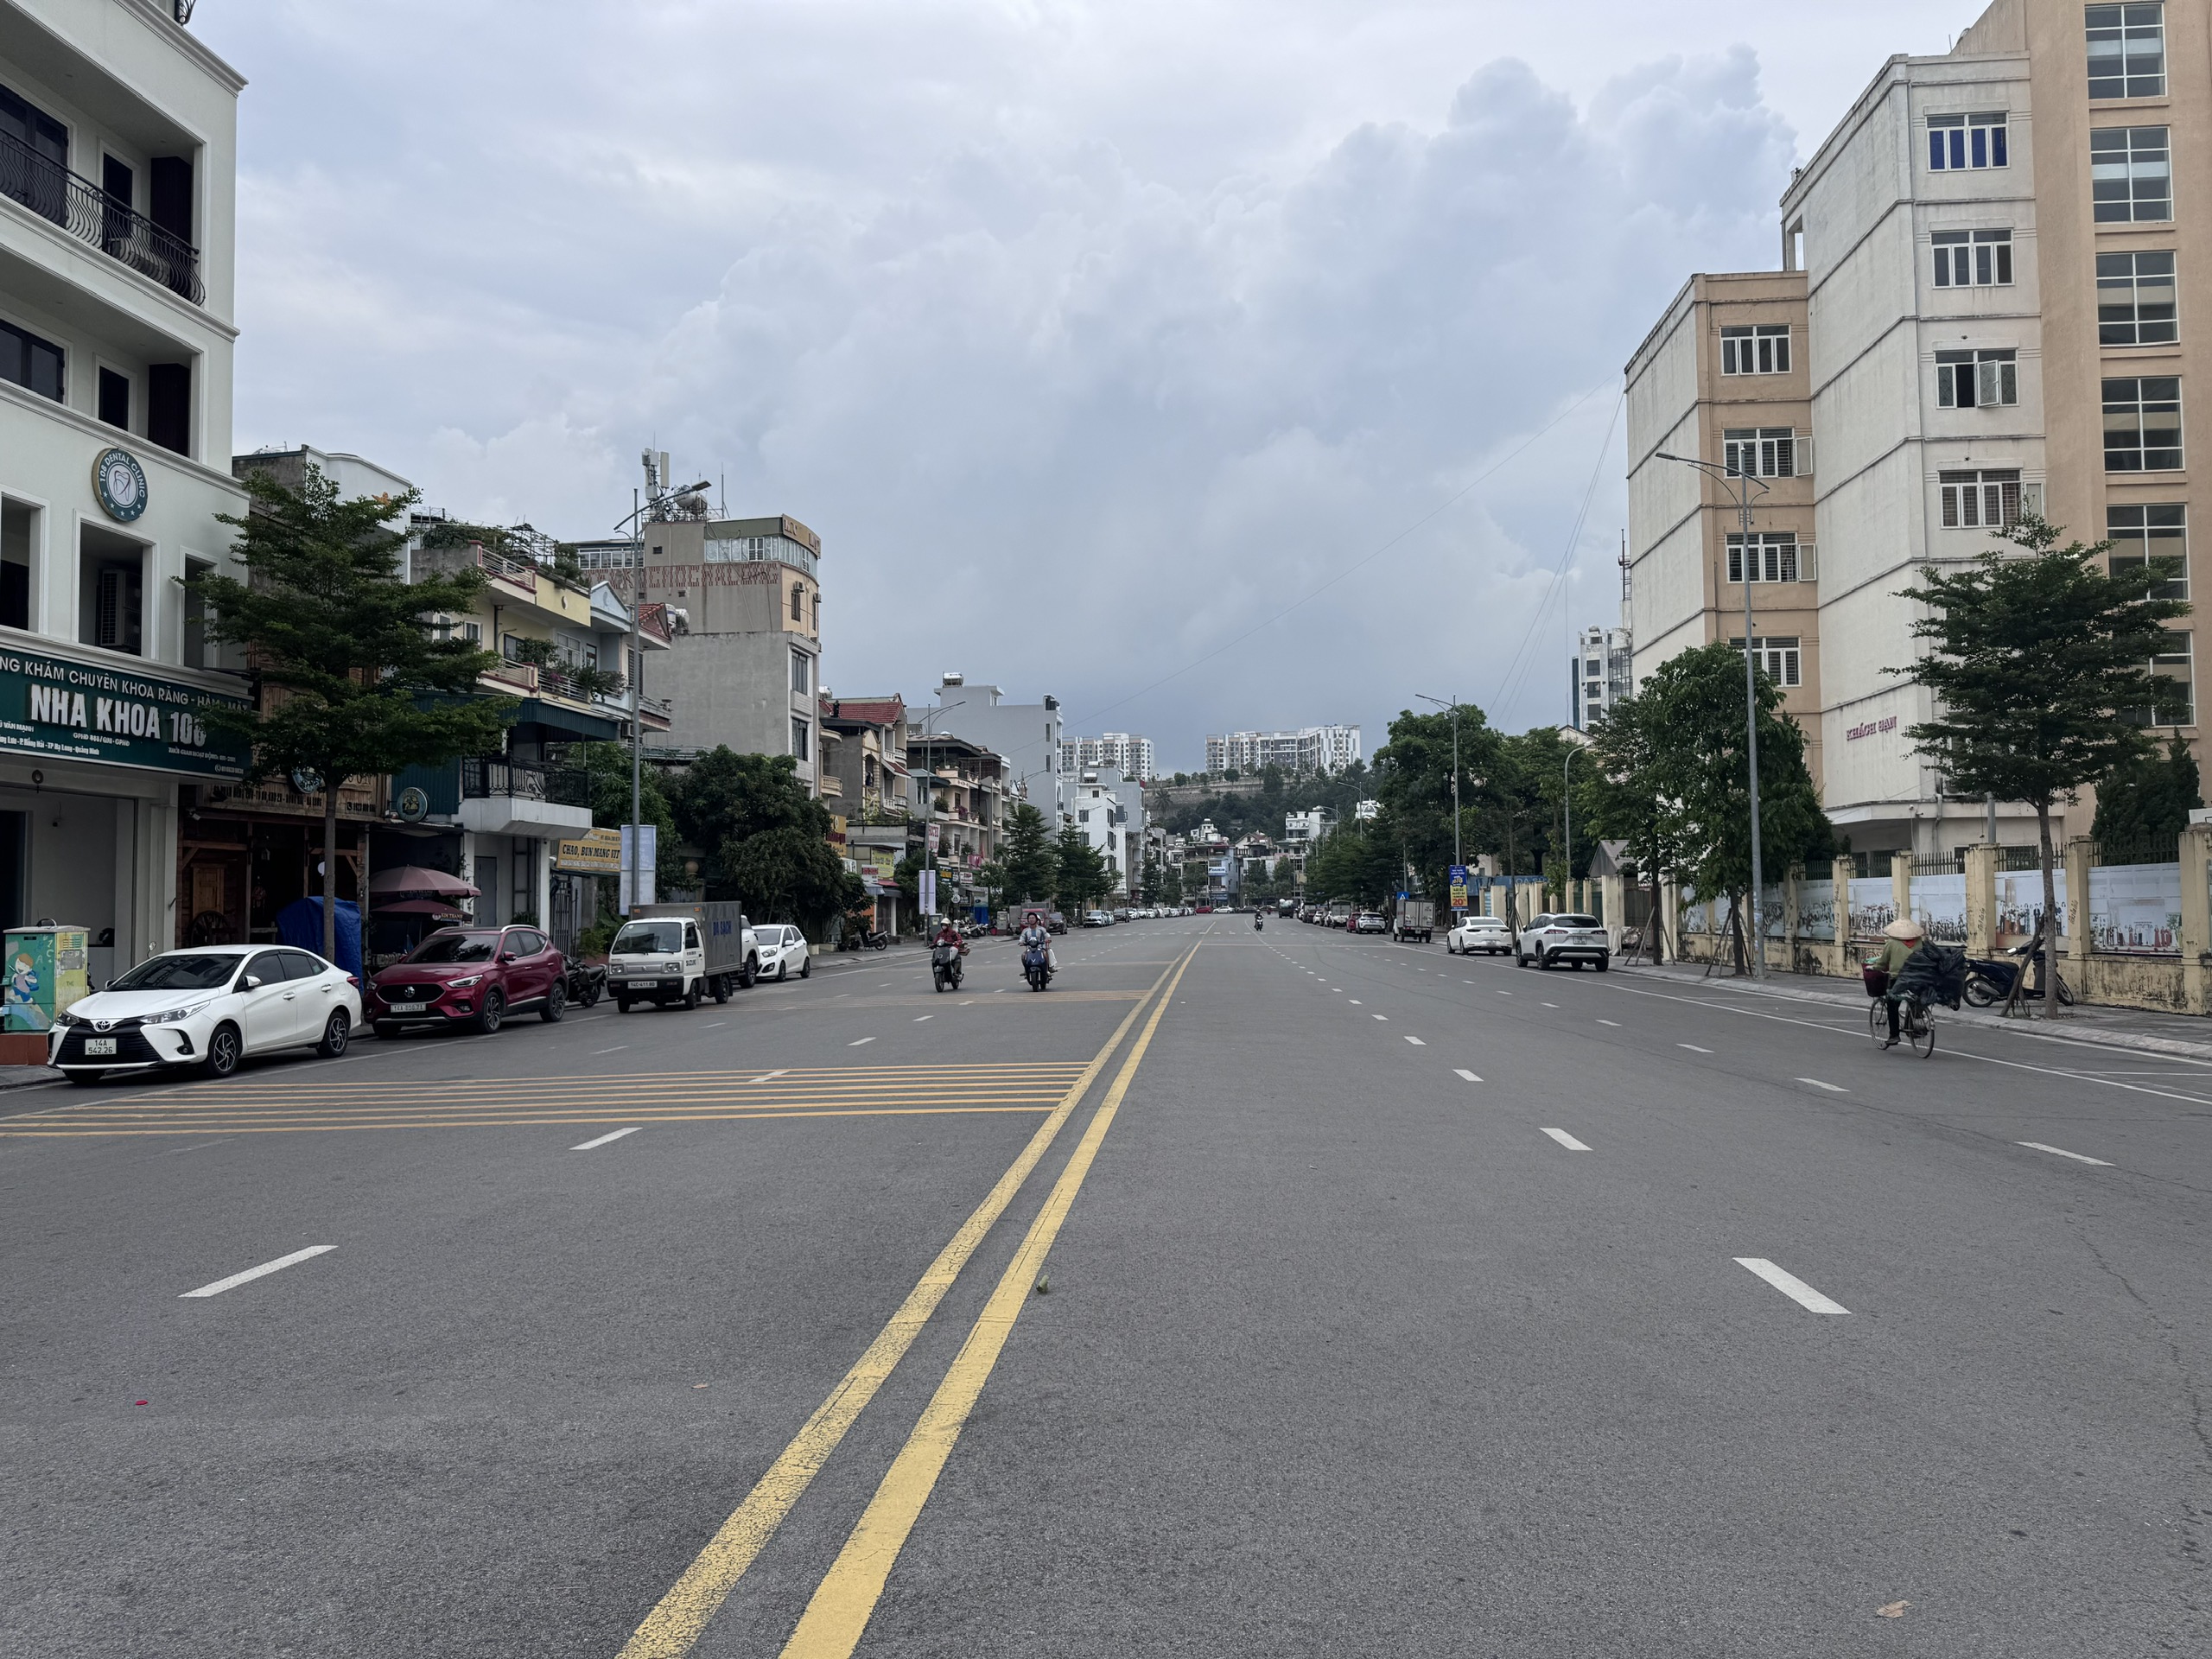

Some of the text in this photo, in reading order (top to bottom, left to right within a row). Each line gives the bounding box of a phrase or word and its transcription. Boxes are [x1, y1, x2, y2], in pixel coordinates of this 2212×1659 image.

[105, 453, 130, 466] DENTAL
[130, 463, 146, 498] CLINIC
[25, 661, 64, 681] KHÁM
[69, 671, 118, 692] CHUYÊN
[122, 680, 154, 699] KHOA
[158, 685, 188, 705] RĂNG
[31, 683, 87, 728] NHA
[96, 696, 161, 740] KHOA
